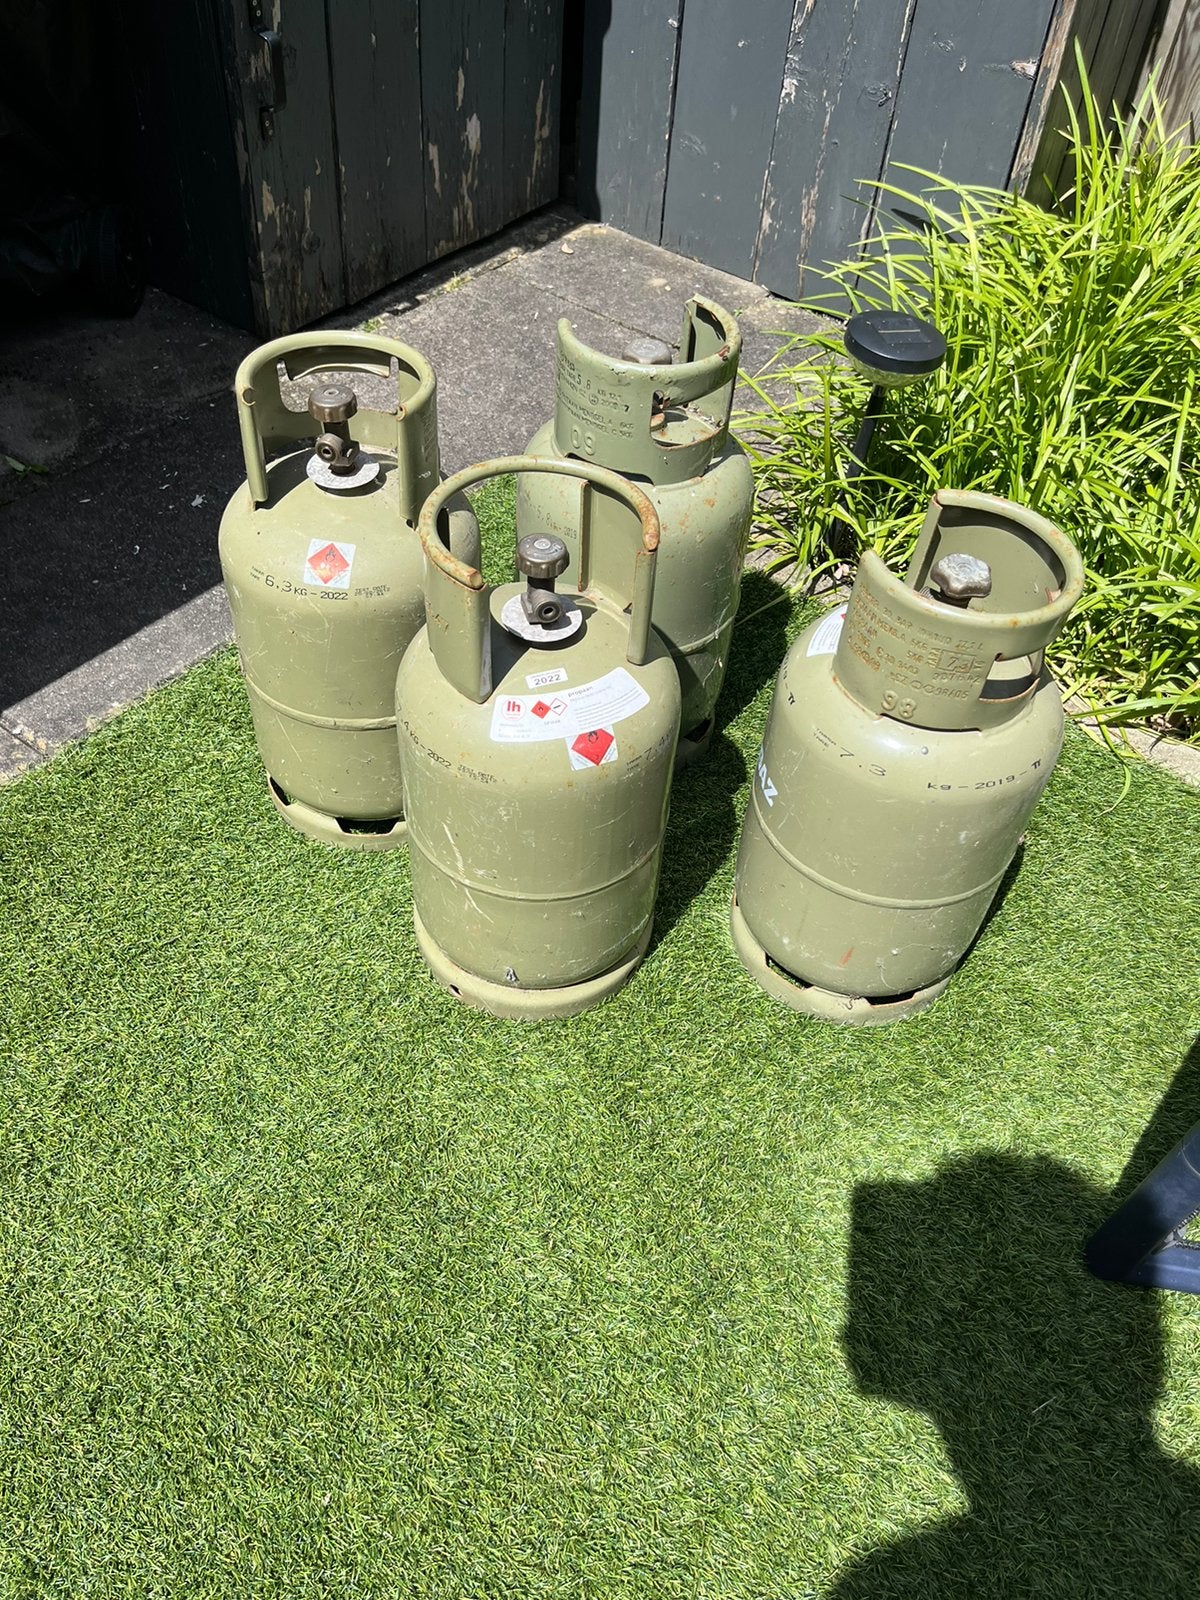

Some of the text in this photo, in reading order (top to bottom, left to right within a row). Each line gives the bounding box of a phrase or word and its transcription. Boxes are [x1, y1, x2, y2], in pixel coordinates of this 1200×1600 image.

[320, 591, 348, 600] 2022
[533, 673, 562, 686] 2022
[881, 689, 917, 719] 98
[427, 748, 452, 769] 2022
[974, 774, 1015, 790] 2019
